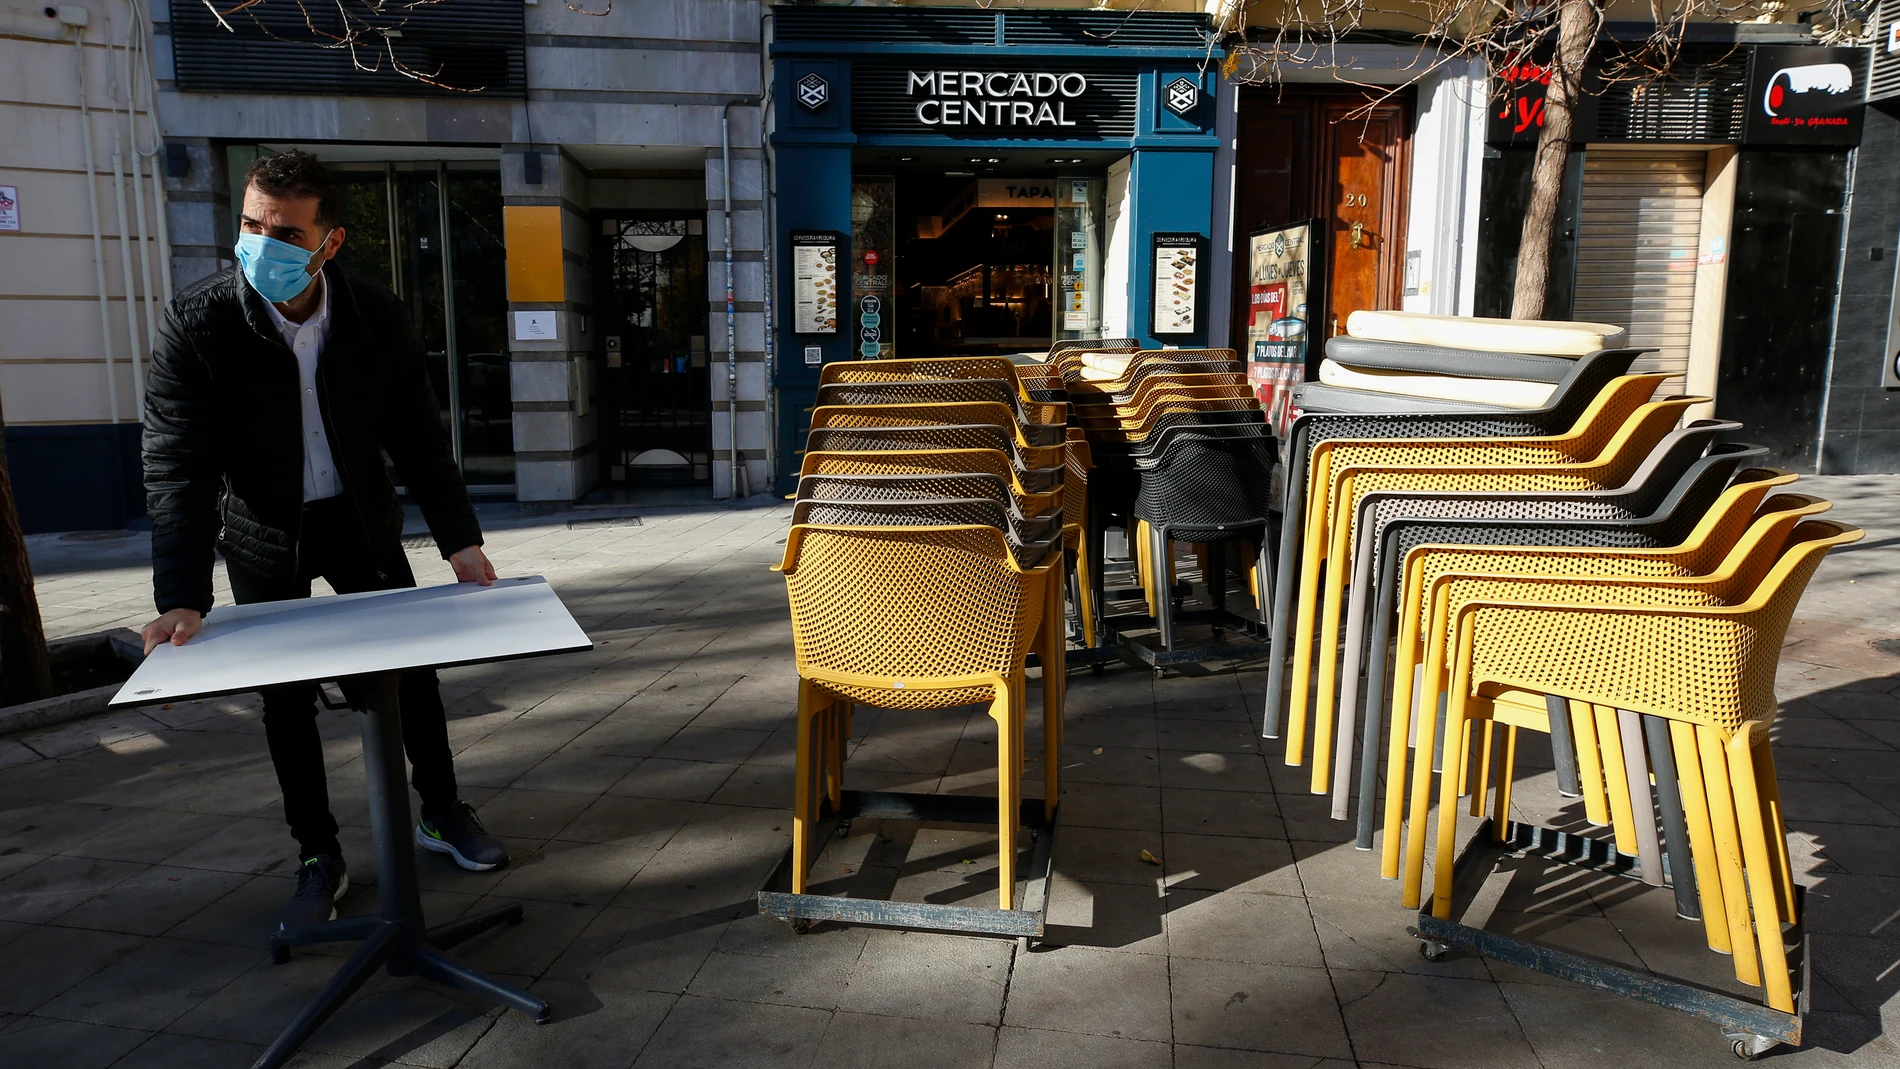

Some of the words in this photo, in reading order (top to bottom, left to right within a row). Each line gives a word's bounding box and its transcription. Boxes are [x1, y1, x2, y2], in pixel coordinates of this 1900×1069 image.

[906, 69, 1086, 97] MERCADO
[915, 99, 1076, 126] CENTRAL
[1808, 117, 1848, 126] GRANADA
[1346, 193, 1367, 207] 20
[1256, 242, 1274, 252] MERCADO
[1285, 237, 1305, 247] CENTRAL
[1259, 264, 1278, 281] LUNES
[1281, 259, 1305, 278] JUEVES
[1251, 293, 1261, 304] LOS
[1271, 291, 1279, 303] DEL
[1279, 287, 1285, 313] 7
[1260, 345, 1277, 358] PLATOS
[1277, 345, 1287, 358] DEL
[1287, 345, 1297, 358] MAR
[1257, 366, 1274, 380] PLATOS
[1274, 367, 1283, 380] DEL
